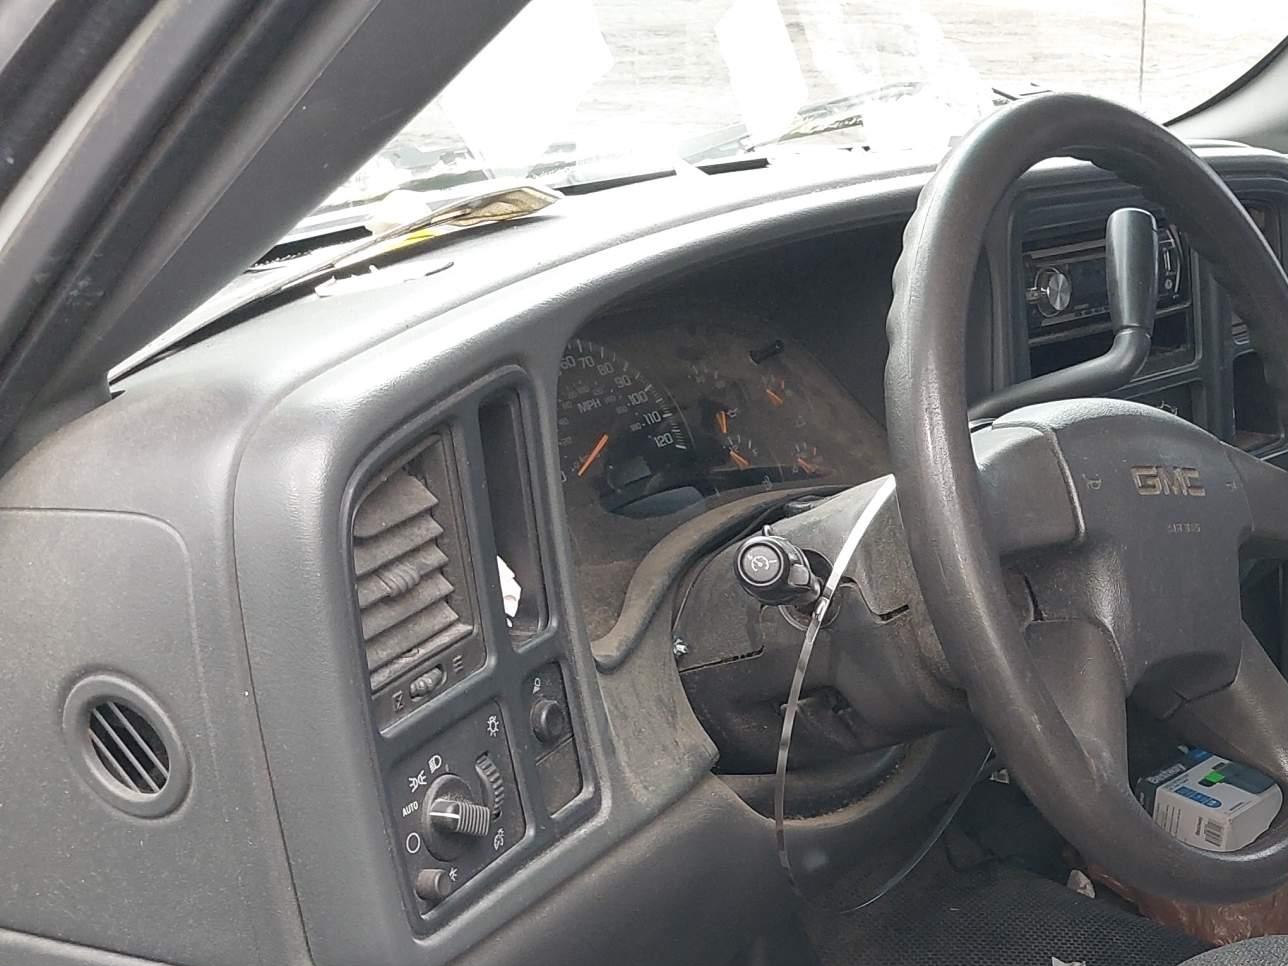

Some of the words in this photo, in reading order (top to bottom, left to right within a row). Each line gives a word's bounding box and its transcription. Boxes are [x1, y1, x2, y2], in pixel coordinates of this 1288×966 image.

[578, 355, 595, 369] 70
[614, 374, 632, 388] 90
[577, 398, 601, 413] MPH
[628, 390, 648, 406] 100
[643, 410, 661, 425] 110
[654, 432, 674, 448] 120
[1130, 466, 1206, 497] GMC
[402, 800, 419, 817] AUTO
